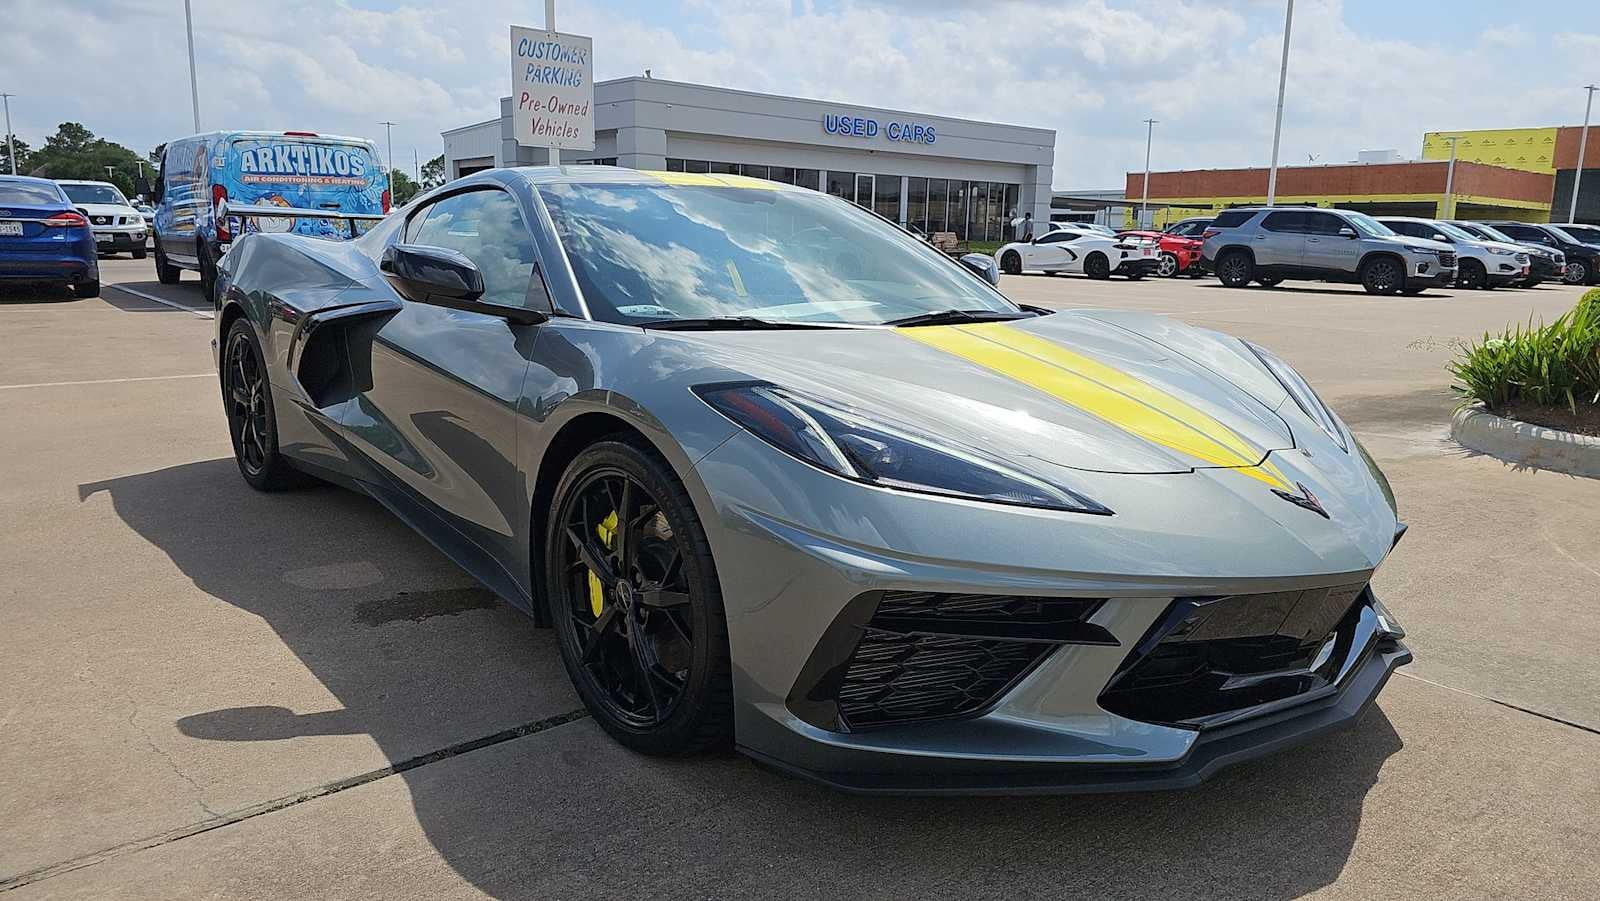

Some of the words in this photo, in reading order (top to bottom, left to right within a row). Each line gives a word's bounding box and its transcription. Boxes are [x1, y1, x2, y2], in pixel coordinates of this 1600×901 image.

[518, 38, 587, 65] CUSTOMER
[525, 62, 582, 88] PARKING
[519, 91, 589, 117] Pre-Owned
[531, 117, 579, 139] Vehicles
[825, 114, 878, 137] USED
[888, 122, 937, 144] CARS
[240, 144, 366, 177] ARKTIKOS
[260, 176, 323, 184] CONDITIONING
